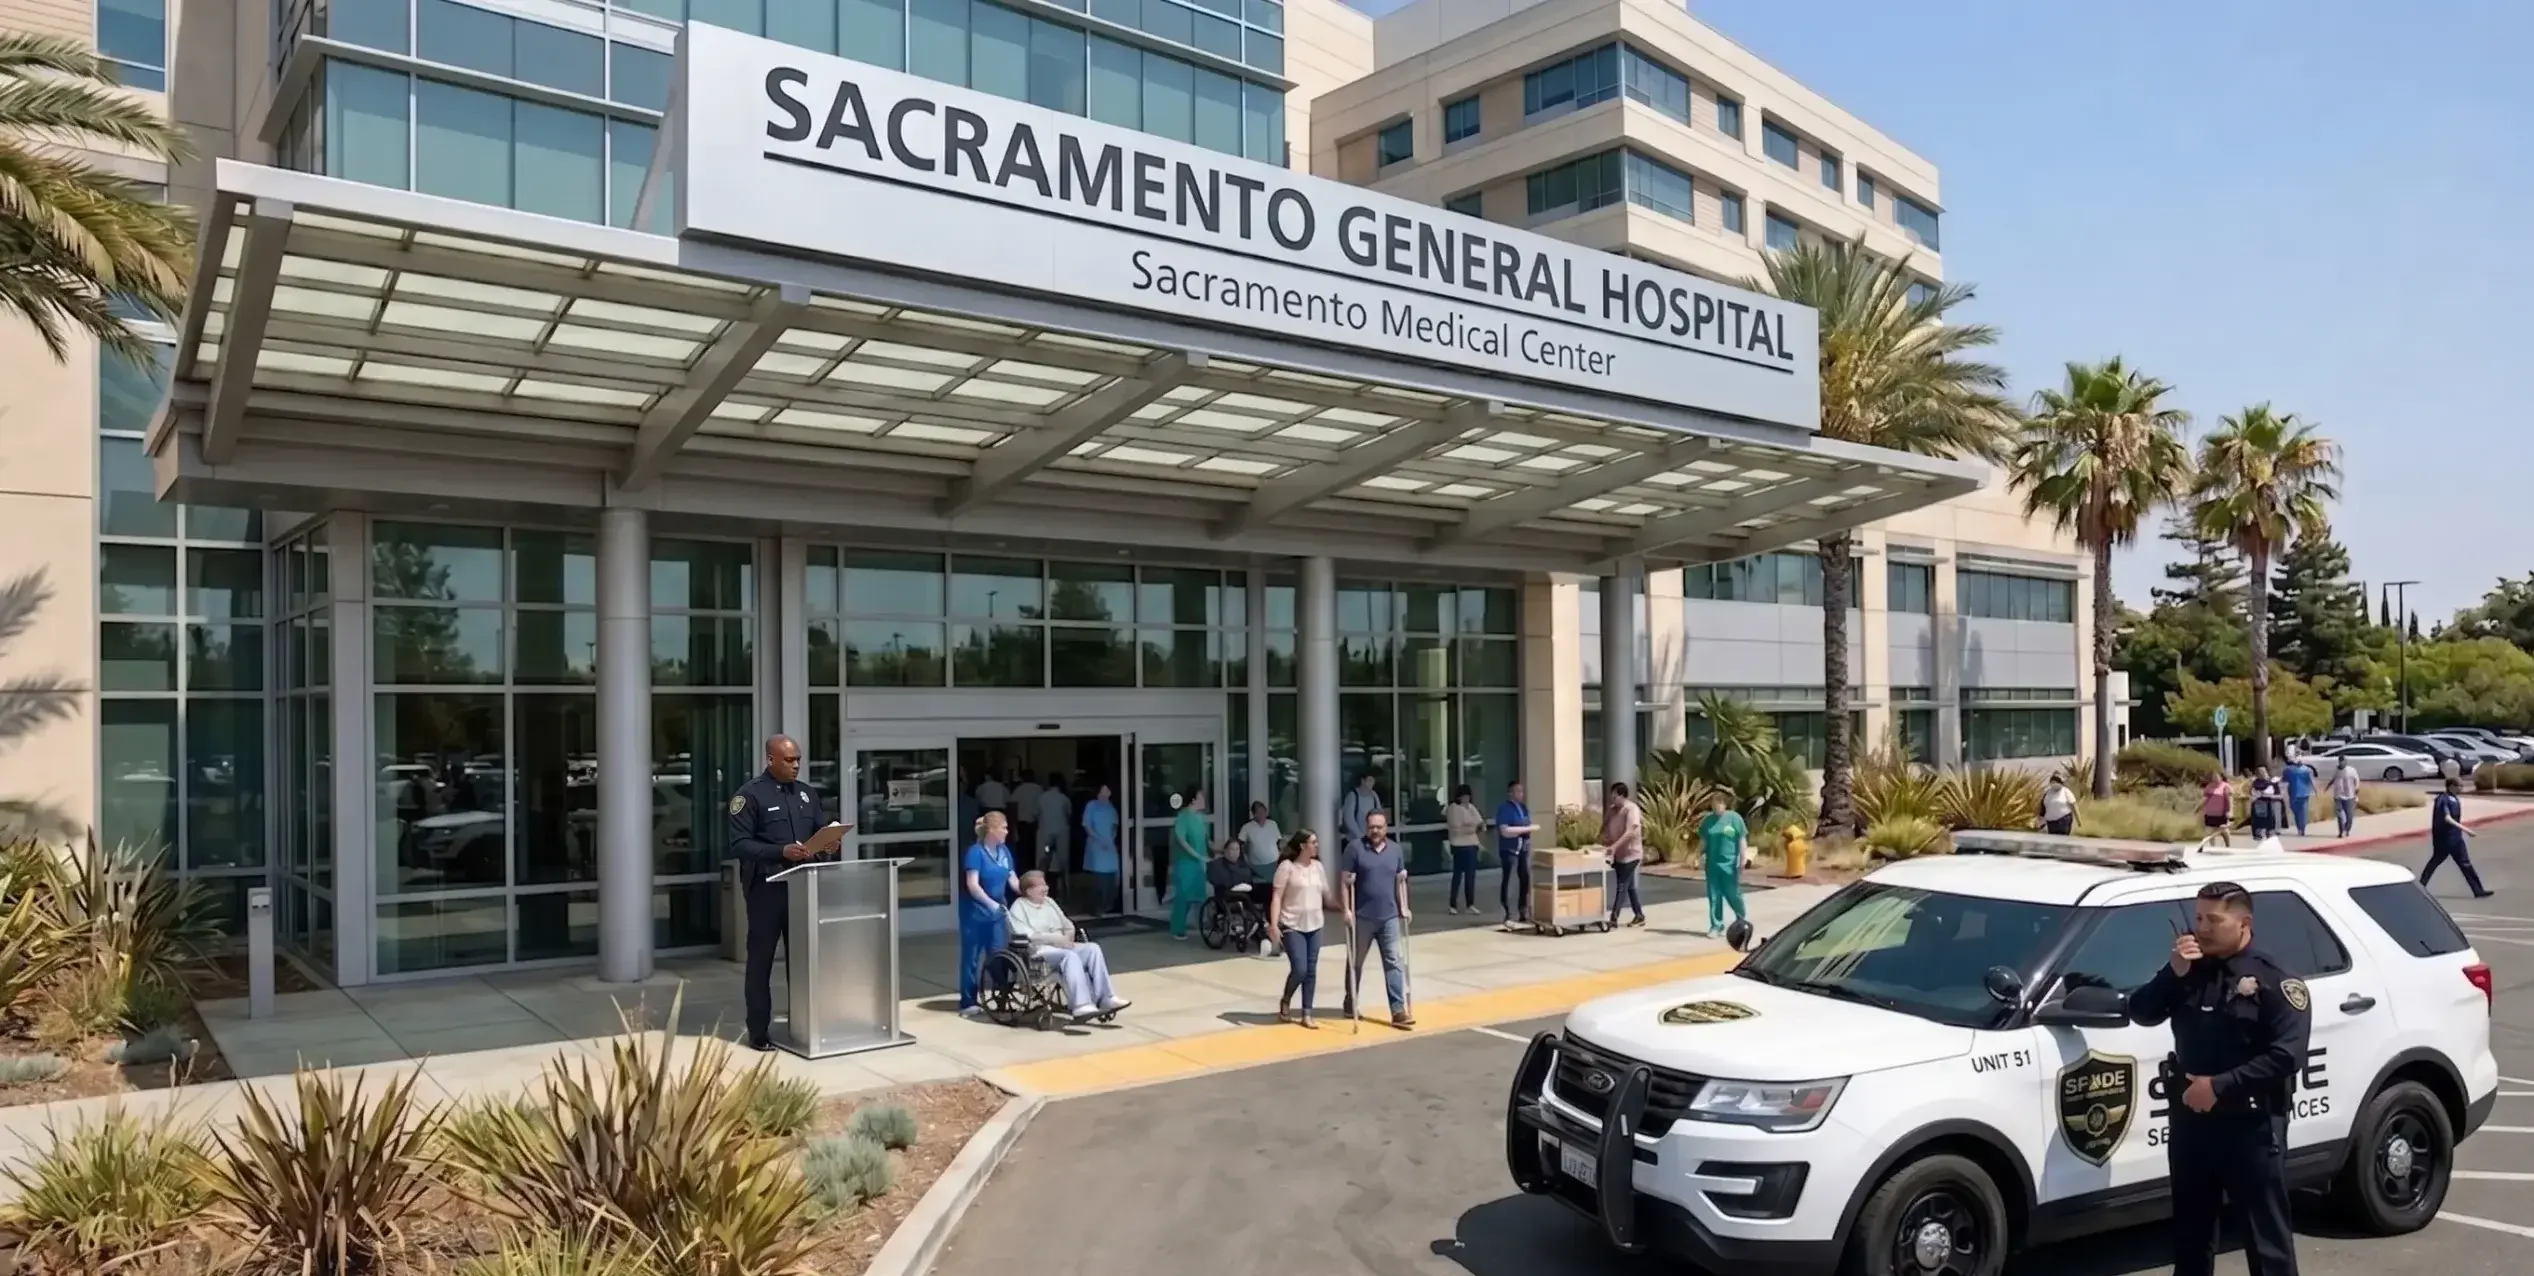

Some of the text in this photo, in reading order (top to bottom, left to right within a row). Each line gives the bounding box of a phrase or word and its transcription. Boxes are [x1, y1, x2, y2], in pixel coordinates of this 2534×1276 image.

[764, 66, 1794, 361] SACRAMENTO GENERAL HOSPITAL
[1131, 250, 1617, 376] Sacramento Medical Center
[1971, 1053, 2008, 1073] UNIT
[2147, 1096, 2330, 1147] SEICES
